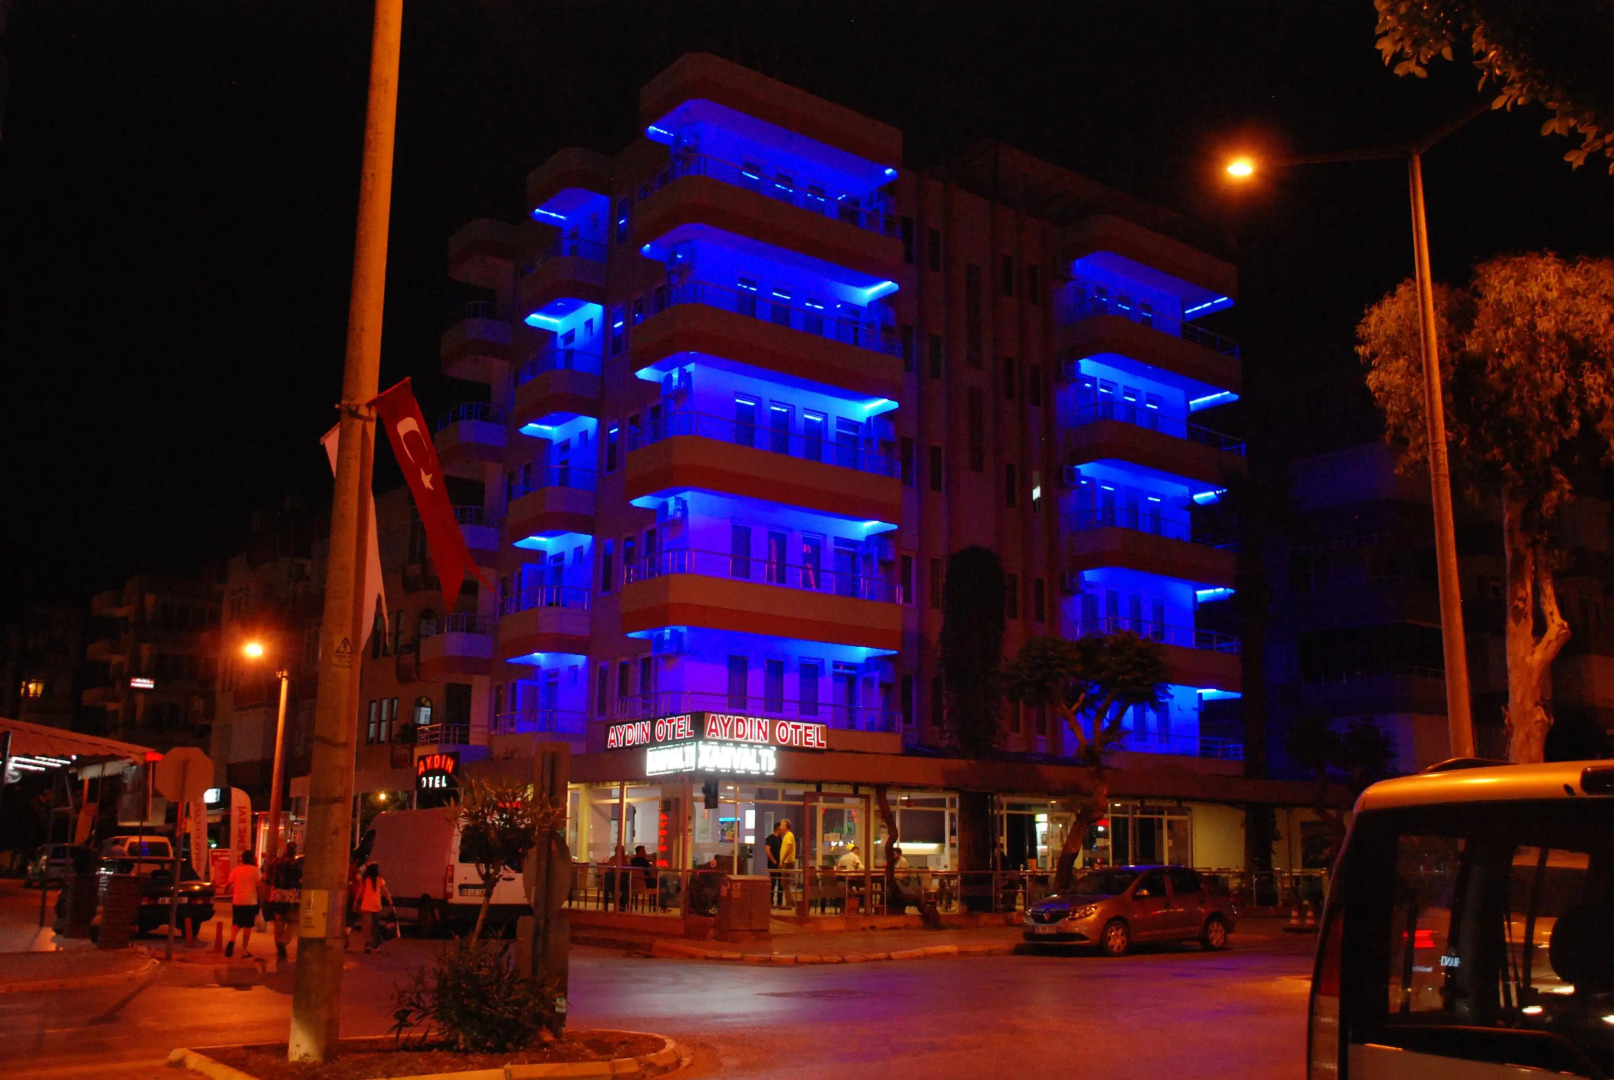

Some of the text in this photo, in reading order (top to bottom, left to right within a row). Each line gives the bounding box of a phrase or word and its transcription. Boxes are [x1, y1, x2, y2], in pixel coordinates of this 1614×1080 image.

[607, 714, 694, 749] AYDIN OTEL
[706, 713, 827, 749] AYDIN OTEL
[418, 754, 454, 776] AYDIN
